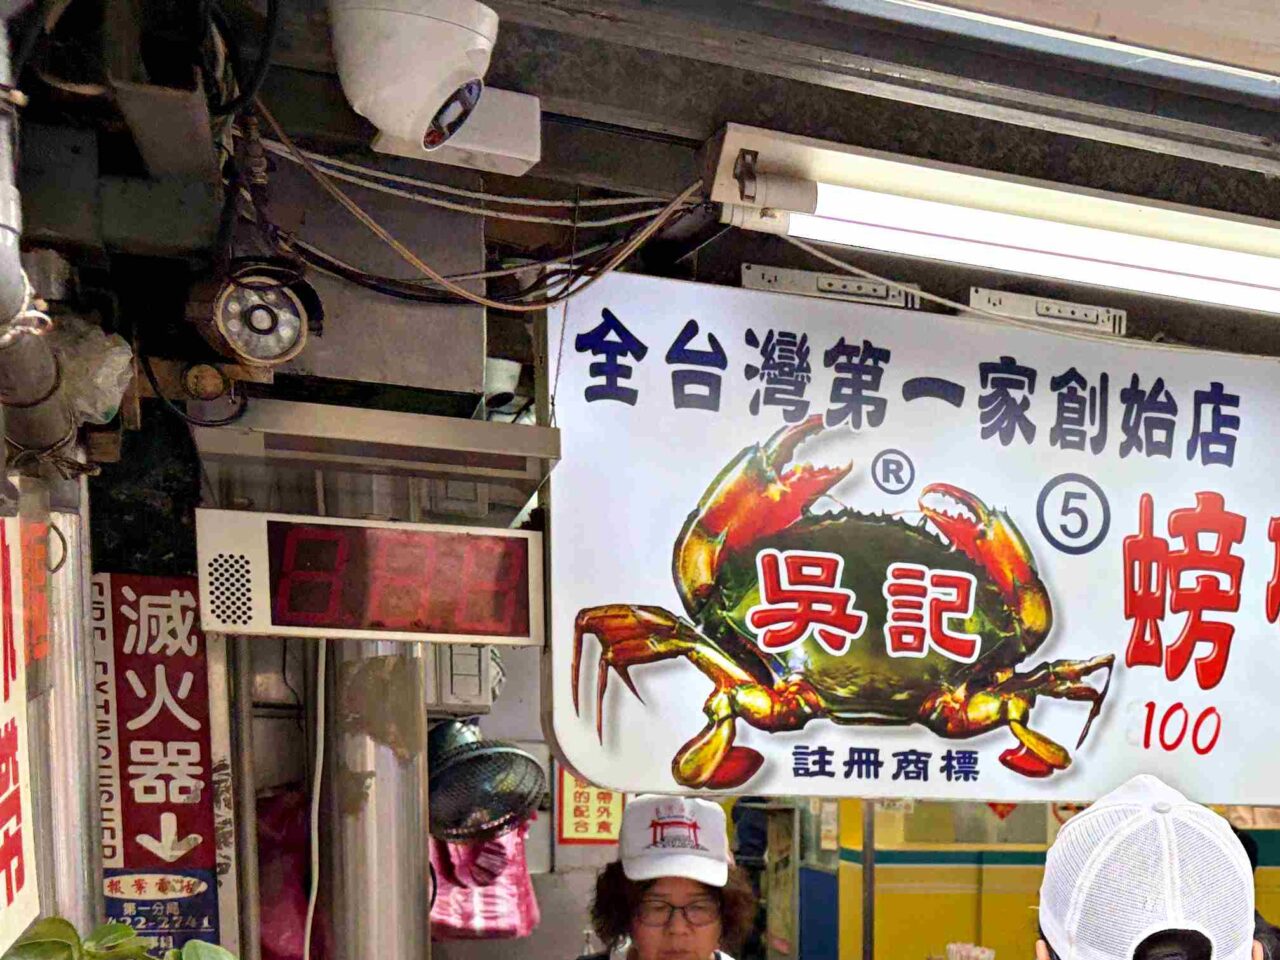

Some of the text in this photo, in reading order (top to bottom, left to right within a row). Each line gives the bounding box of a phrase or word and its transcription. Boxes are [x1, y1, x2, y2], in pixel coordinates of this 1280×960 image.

[574, 307, 1241, 468] 全台灣第一家創始店
[750, 551, 983, 662] 吳記
[121, 586, 206, 804] 滅火器
[1143, 701, 1222, 755] 100
[792, 745, 981, 782] 註冊商標
